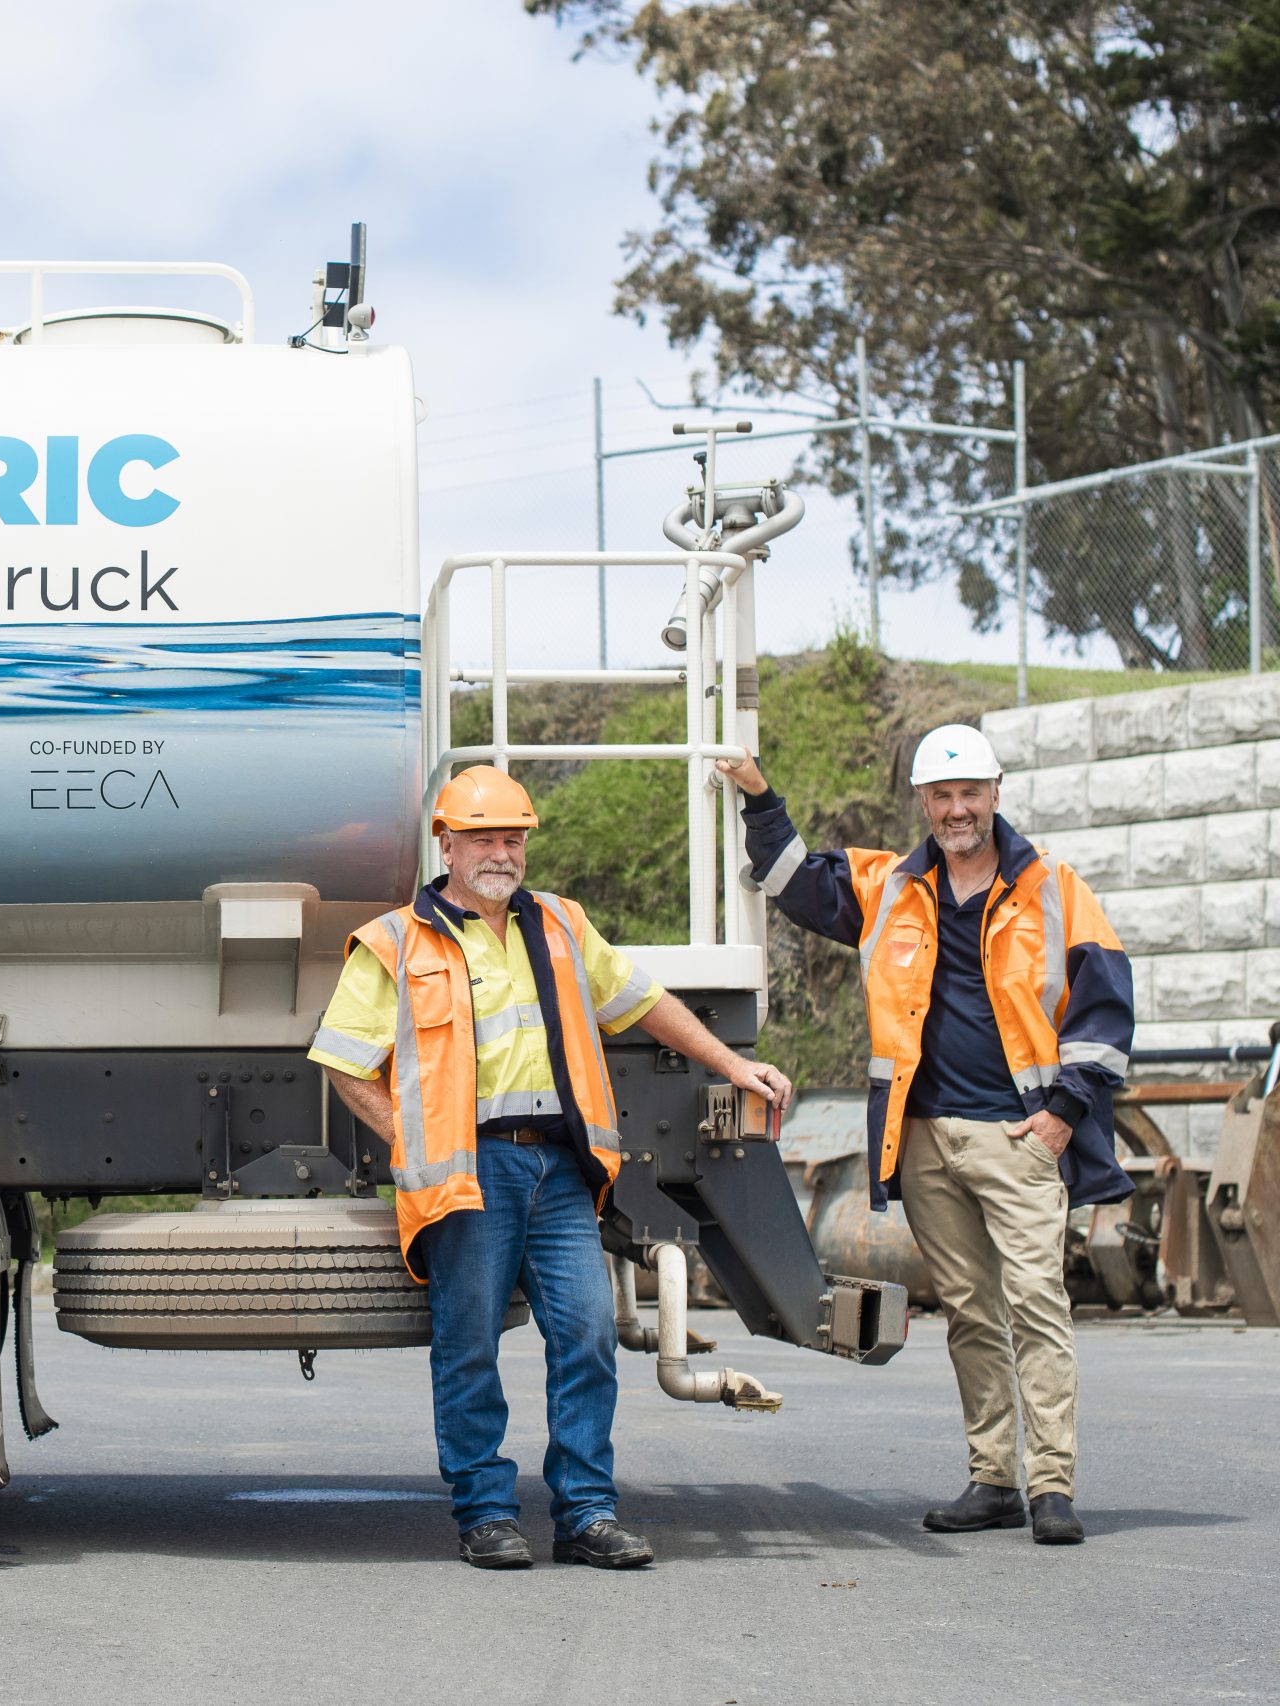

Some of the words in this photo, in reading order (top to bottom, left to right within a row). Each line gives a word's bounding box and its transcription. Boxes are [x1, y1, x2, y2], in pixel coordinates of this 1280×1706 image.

[29, 740, 137, 755] CO-FUNDED
[142, 740, 165, 755] BY
[30, 769, 180, 810] EECA
